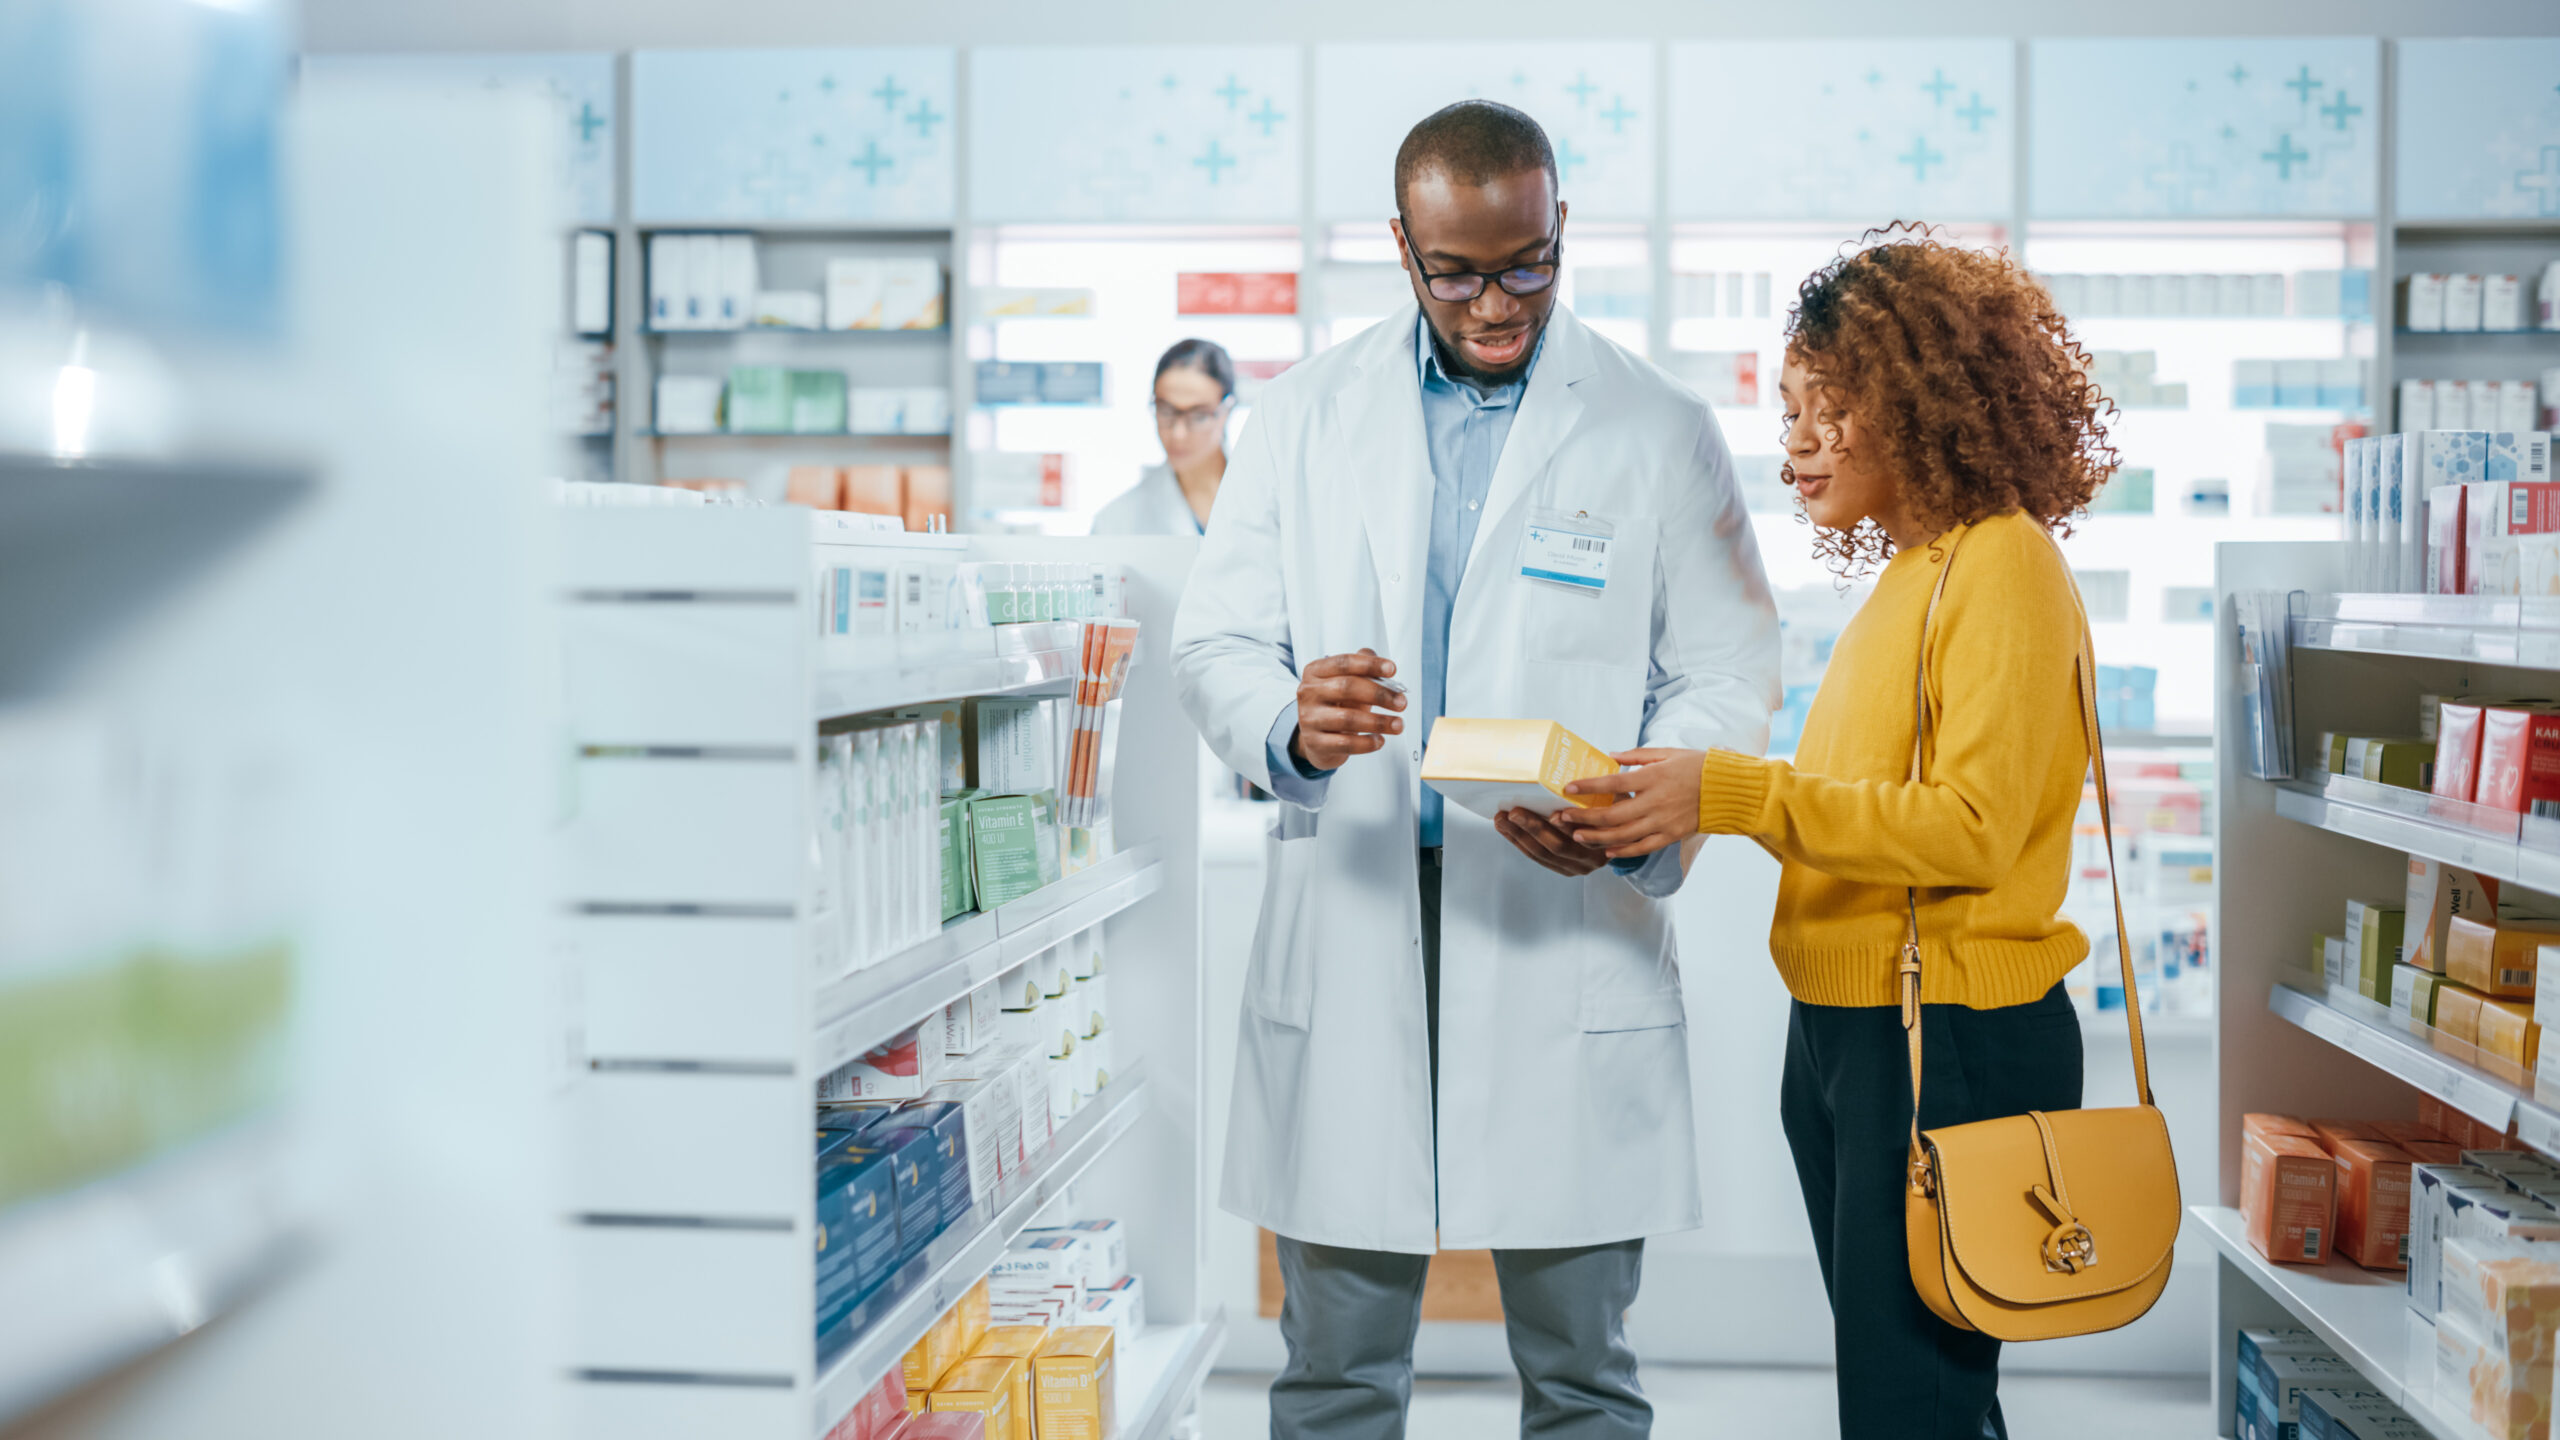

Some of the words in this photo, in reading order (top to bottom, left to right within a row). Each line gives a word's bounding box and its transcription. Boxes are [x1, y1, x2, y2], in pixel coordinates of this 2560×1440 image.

[1551, 747, 1570, 785] Vitamin
[979, 813, 1016, 829] Vitamin
[1017, 812, 1025, 826] E
[2450, 888, 2461, 914] Well
[2281, 1170, 2317, 1187] Vitamin
[2318, 1175, 2326, 1188] A
[1014, 1262, 1034, 1271] Fish
[1036, 1261, 1050, 1271] Oil
[1041, 1373, 1078, 1389] Vitamin
